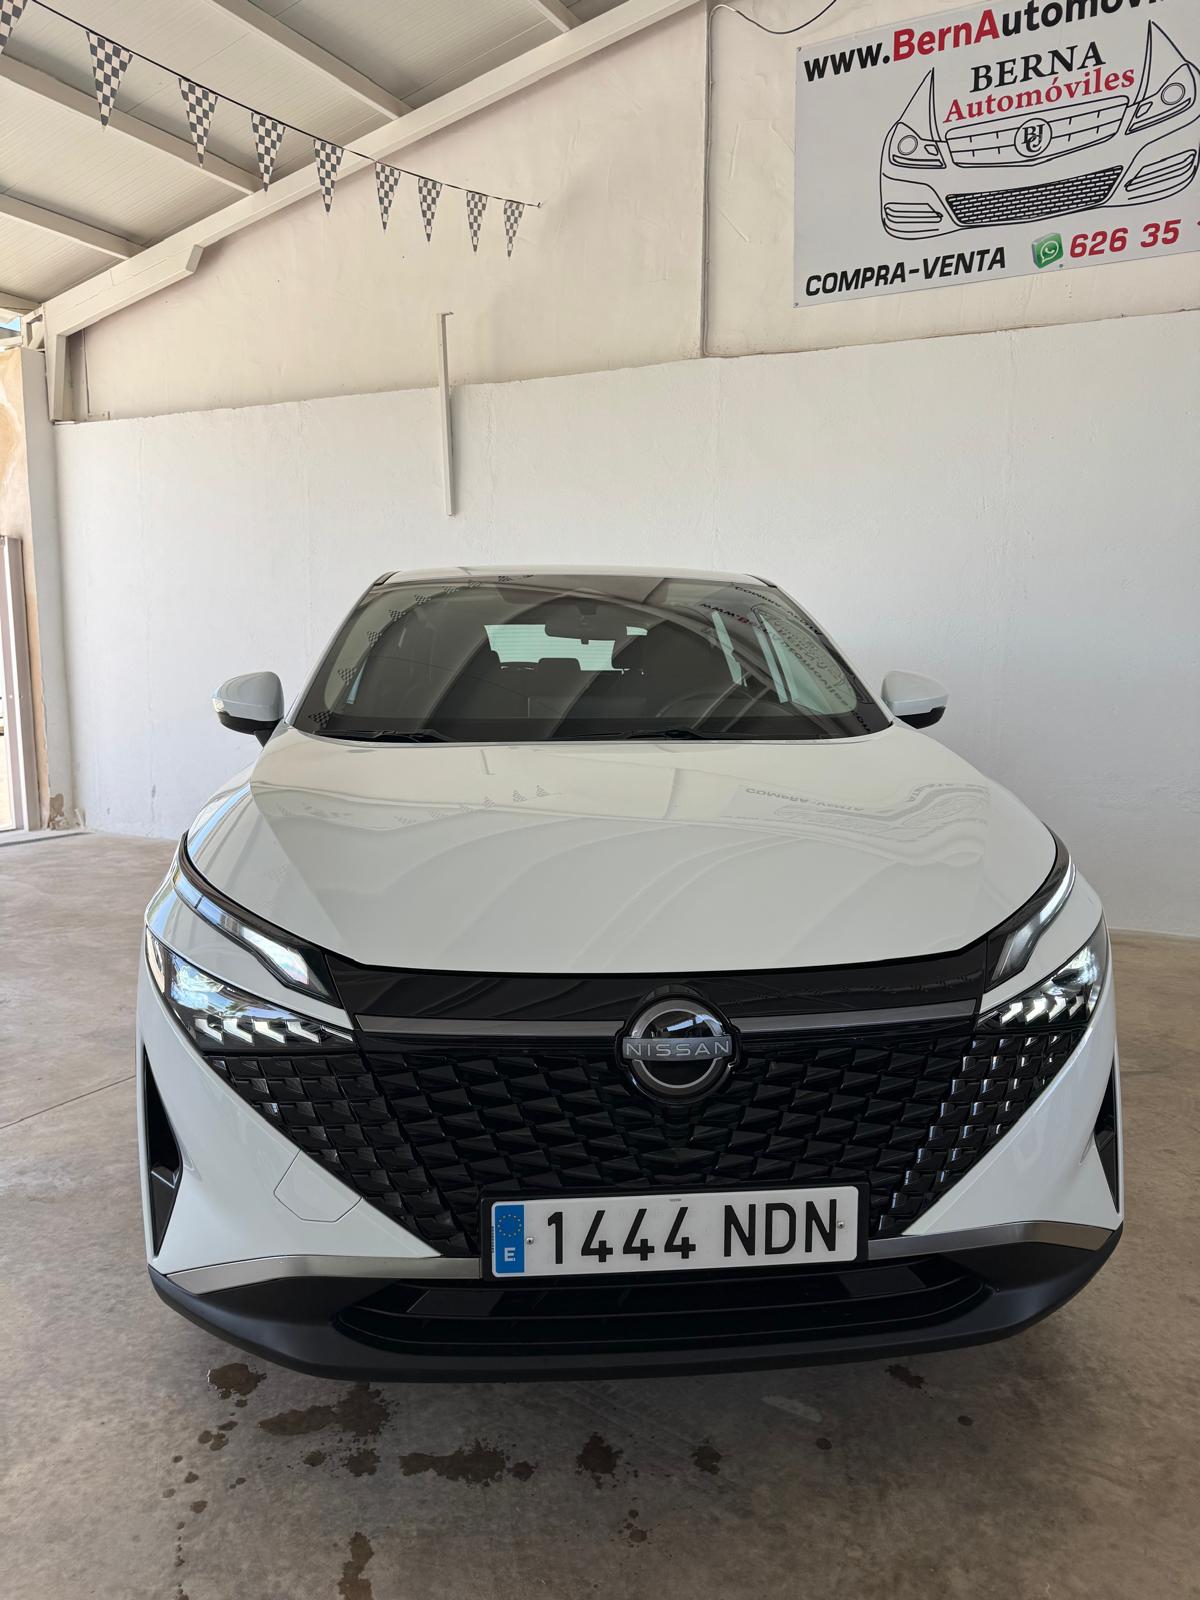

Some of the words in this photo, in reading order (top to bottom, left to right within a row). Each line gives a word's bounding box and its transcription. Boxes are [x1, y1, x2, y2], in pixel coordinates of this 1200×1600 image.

[804, 0, 1157, 82] www.BernAutomo
[969, 41, 1106, 93] BERNA
[943, 67, 1135, 123] Automóviles
[1069, 227, 1129, 259] 626
[1140, 218, 1182, 248] 35
[805, 246, 1006, 296] COMPRA-VENTA
[626, 1040, 729, 1057] NISSAN
[504, 1247, 516, 1262] E
[547, 1206, 697, 1265] 1444
[723, 1198, 838, 1257] NDN
